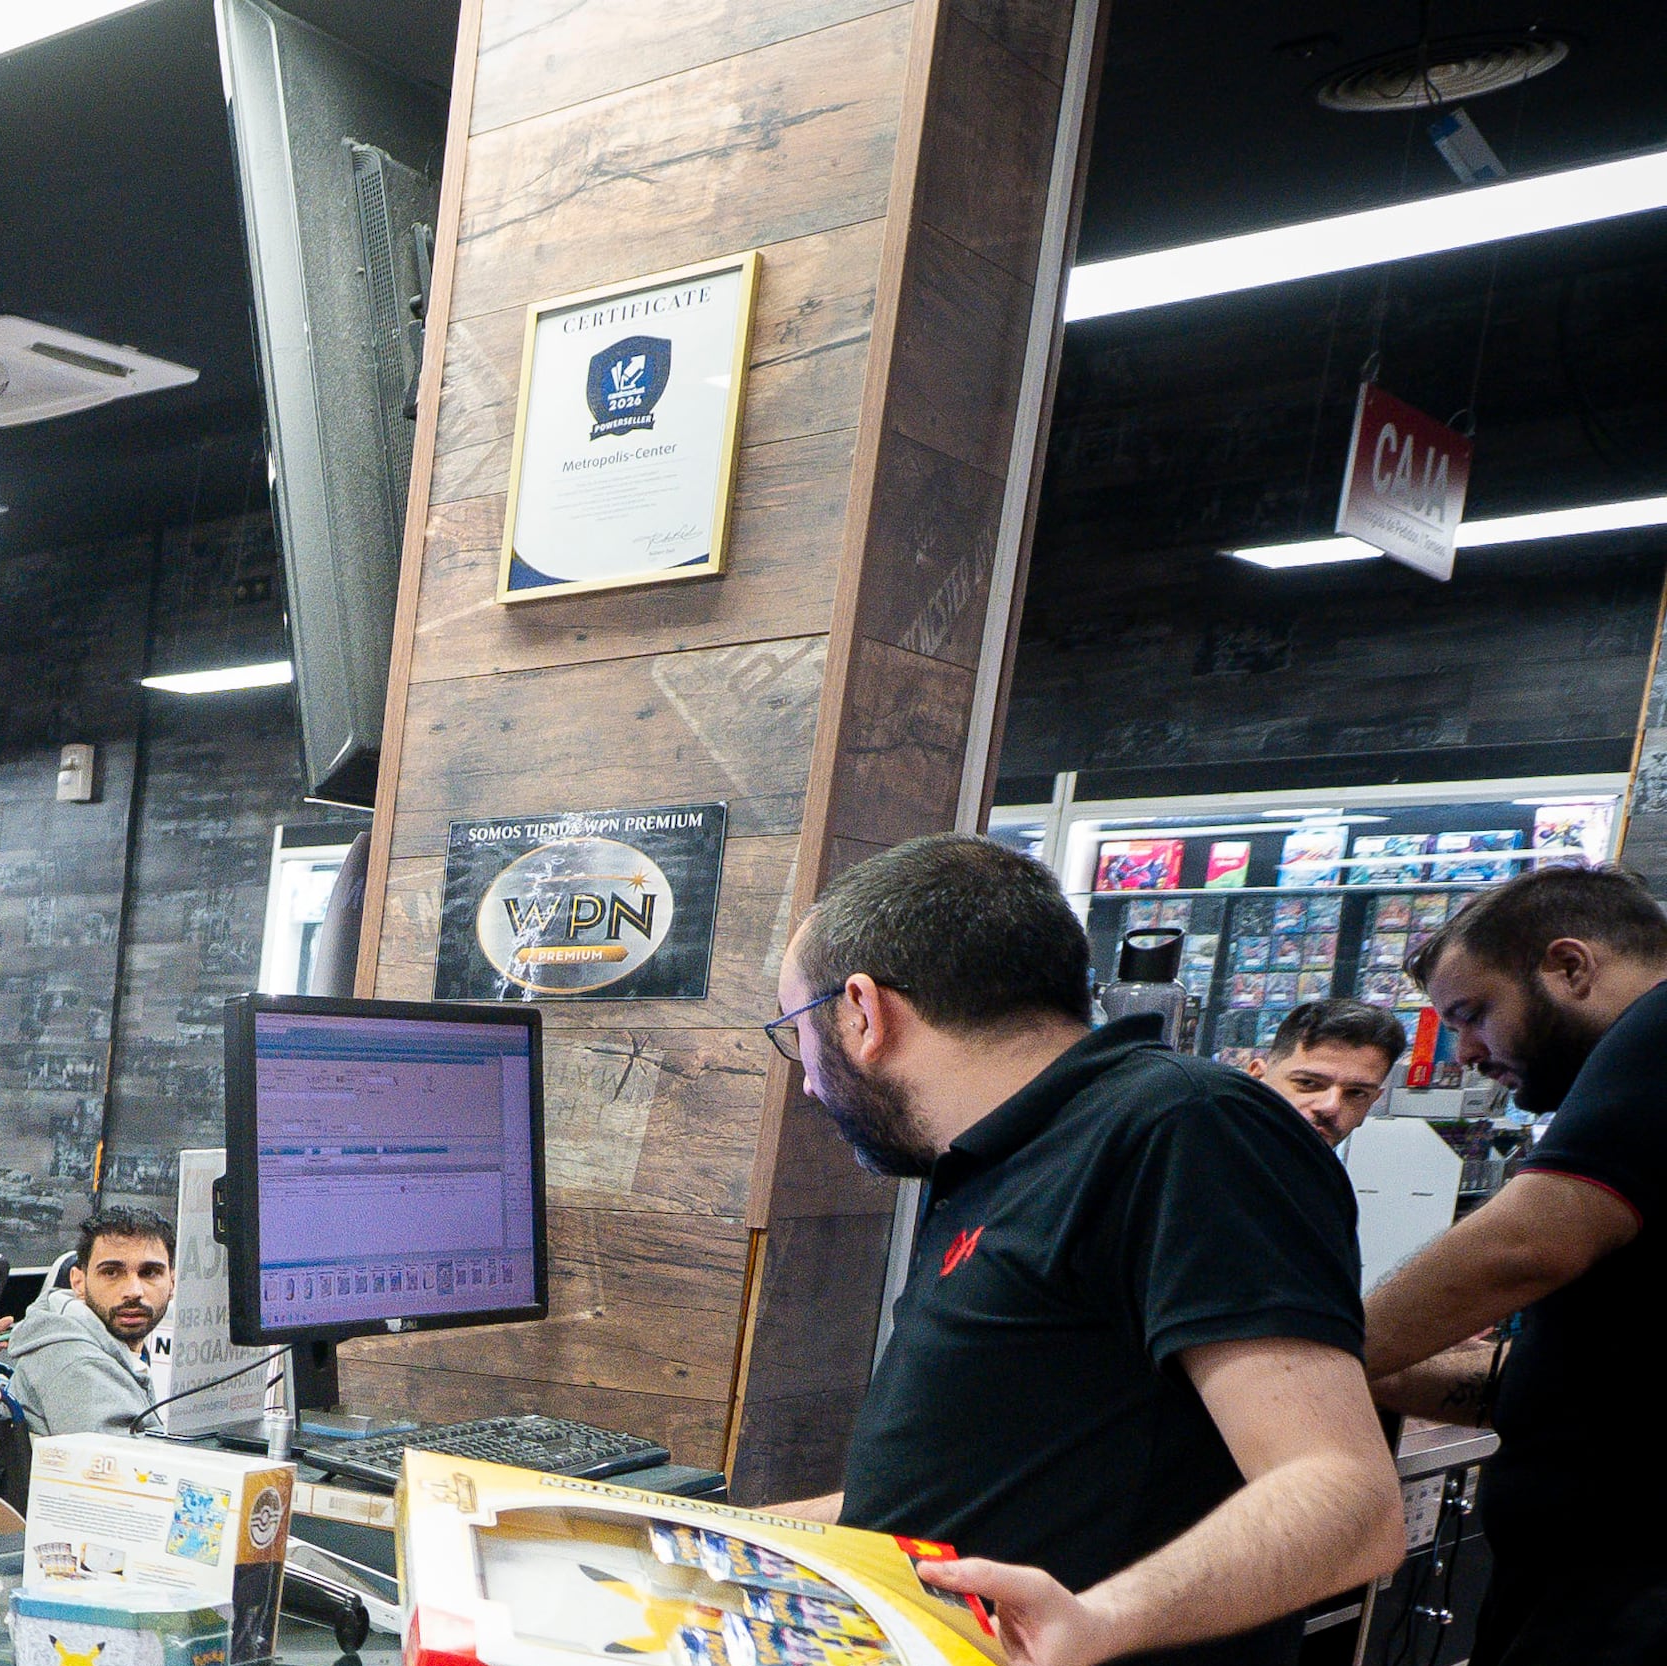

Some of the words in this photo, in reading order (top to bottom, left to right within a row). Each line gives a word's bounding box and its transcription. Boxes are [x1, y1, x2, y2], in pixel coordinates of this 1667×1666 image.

[563, 285, 713, 335] CERTIFICATE
[609, 394, 643, 412] 2026
[593, 412, 655, 434] POWERSELLER
[562, 443, 679, 473] Metropolis-Center
[1372, 422, 1450, 523] CAJA
[467, 824, 522, 843] SOMOS
[523, 818, 580, 839] TIENDA
[582, 816, 620, 835] WPN
[624, 812, 704, 832] PREMIUM
[501, 890, 659, 942] WPN
[537, 949, 603, 962] PREMIUM
[90, 1455, 117, 1474] 30
